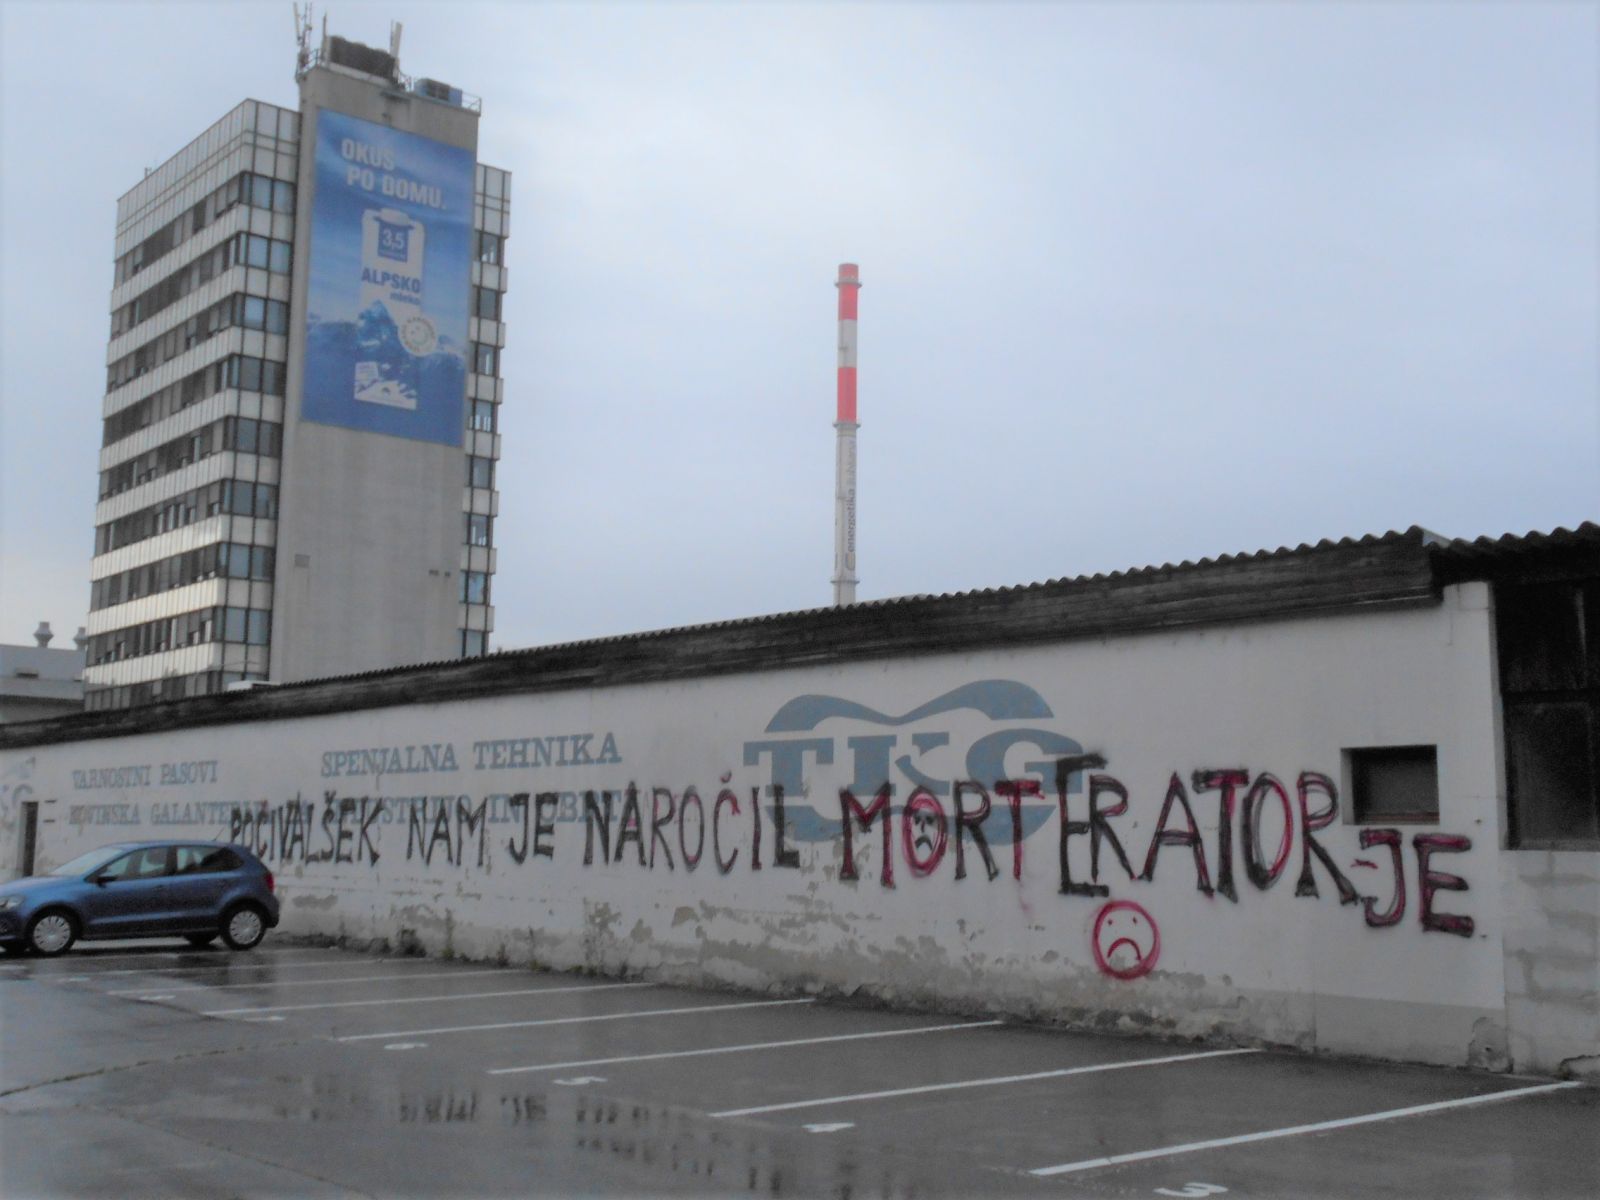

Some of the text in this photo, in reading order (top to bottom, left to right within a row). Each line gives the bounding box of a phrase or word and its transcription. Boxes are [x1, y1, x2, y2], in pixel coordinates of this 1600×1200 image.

[341, 138, 395, 171] OKUS
[347, 165, 447, 210] PO DOMU.
[361, 267, 421, 294] ALPSKO
[160, 760, 218, 784] PASOVI
[320, 732, 622, 778] SPENJALNA TEHNIKA
[406, 794, 488, 867] NAM
[508, 791, 558, 866] JE
[582, 769, 800, 876] NAROČIL
